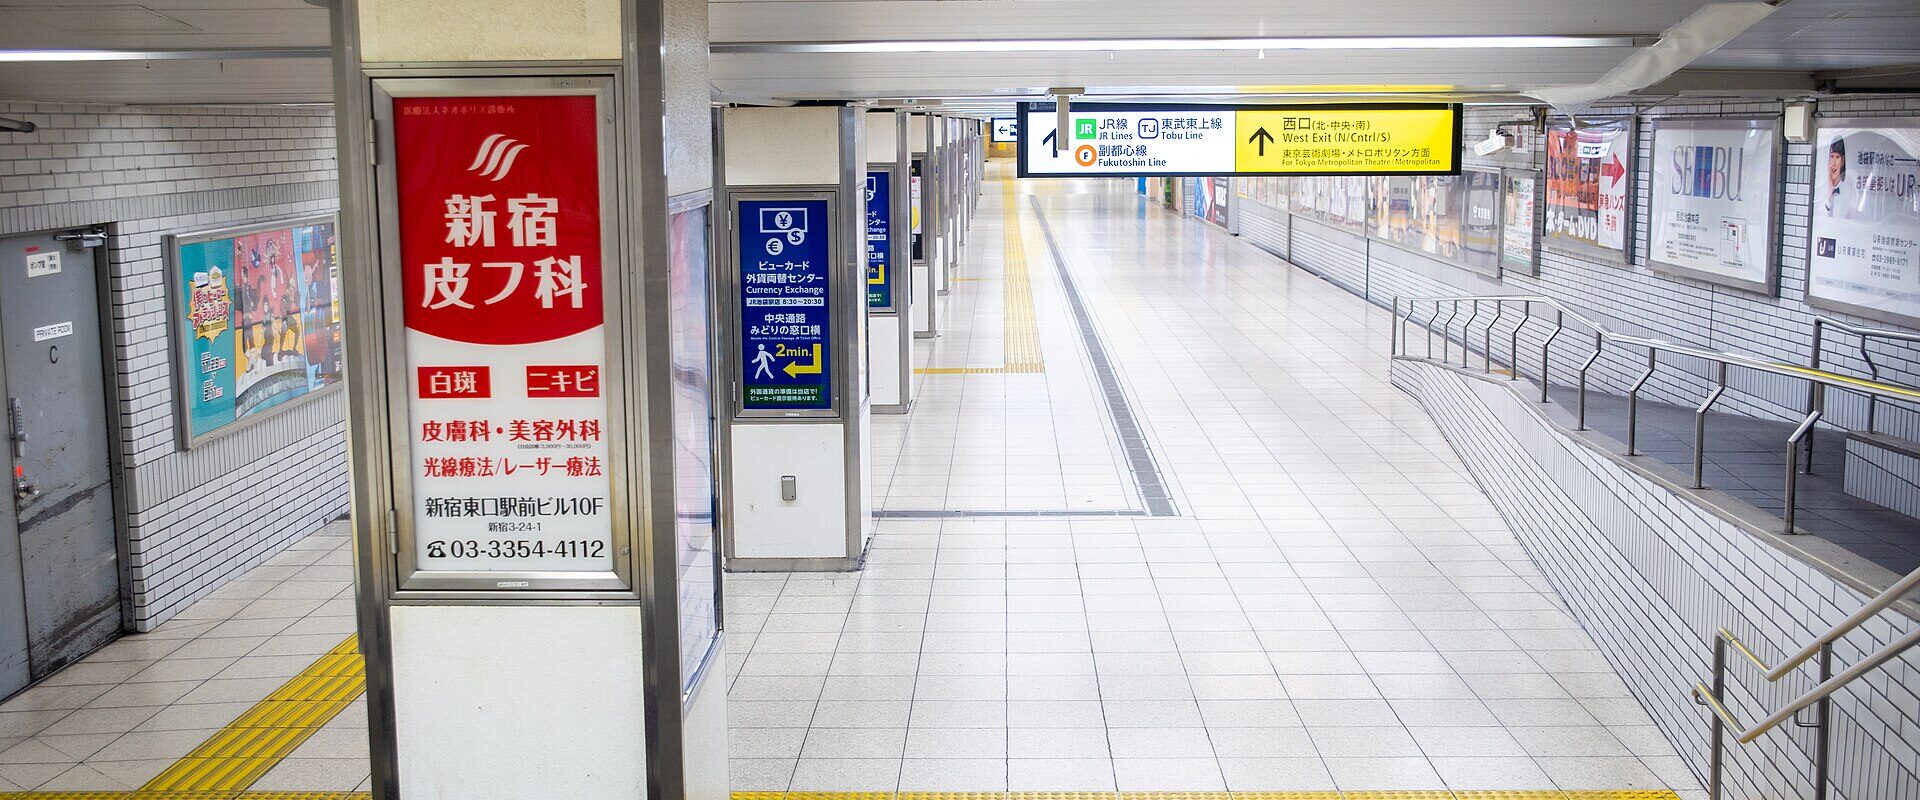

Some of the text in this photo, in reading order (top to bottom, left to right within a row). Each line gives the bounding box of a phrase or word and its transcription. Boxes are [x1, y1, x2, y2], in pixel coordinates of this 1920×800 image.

[1078, 123, 1093, 135] JR
[1099, 118, 1128, 130] JR線
[1141, 124, 1156, 133] TJ
[1161, 118, 1223, 130] 東武東上線
[1099, 131, 1133, 140] JR Lines
[1161, 131, 1203, 140] Tobu Line
[1283, 133, 1309, 143] West
[1312, 132, 1332, 143] Exit
[1098, 145, 1147, 157] 副都心線
[1282, 149, 1430, 158] 東京芸術劇場・メトロポリタン方面
[1098, 158, 1167, 167] Fukutoshin Line
[1282, 158, 1293, 166] For
[1295, 158, 1317, 167] Tokyo
[1318, 158, 1363, 168] Metropolitan
[445, 193, 559, 247] 新宿
[758, 261, 810, 271] ビューカード
[422, 255, 588, 310] 皮フ科
[746, 273, 824, 284] 外貨両替センター
[746, 286, 824, 296] Currency Exchange
[764, 313, 806, 324] 中央通路
[36, 324, 71, 338] PRIVATE ROOM
[750, 325, 821, 336] みどりの窓口横
[49, 345, 59, 365] C
[775, 343, 813, 358] 2min.
[430, 371, 478, 395] 白斑
[529, 369, 596, 393] ニキビ
[422, 419, 602, 442] 皮膚科・美容外科
[424, 456, 602, 477] 光線療法/レーザー療法
[426, 497, 604, 518] 新宿東口駅前ビル10F
[488, 522, 541, 532] 新宿3-24-1
[451, 540, 605, 558] 03-3354-4112
